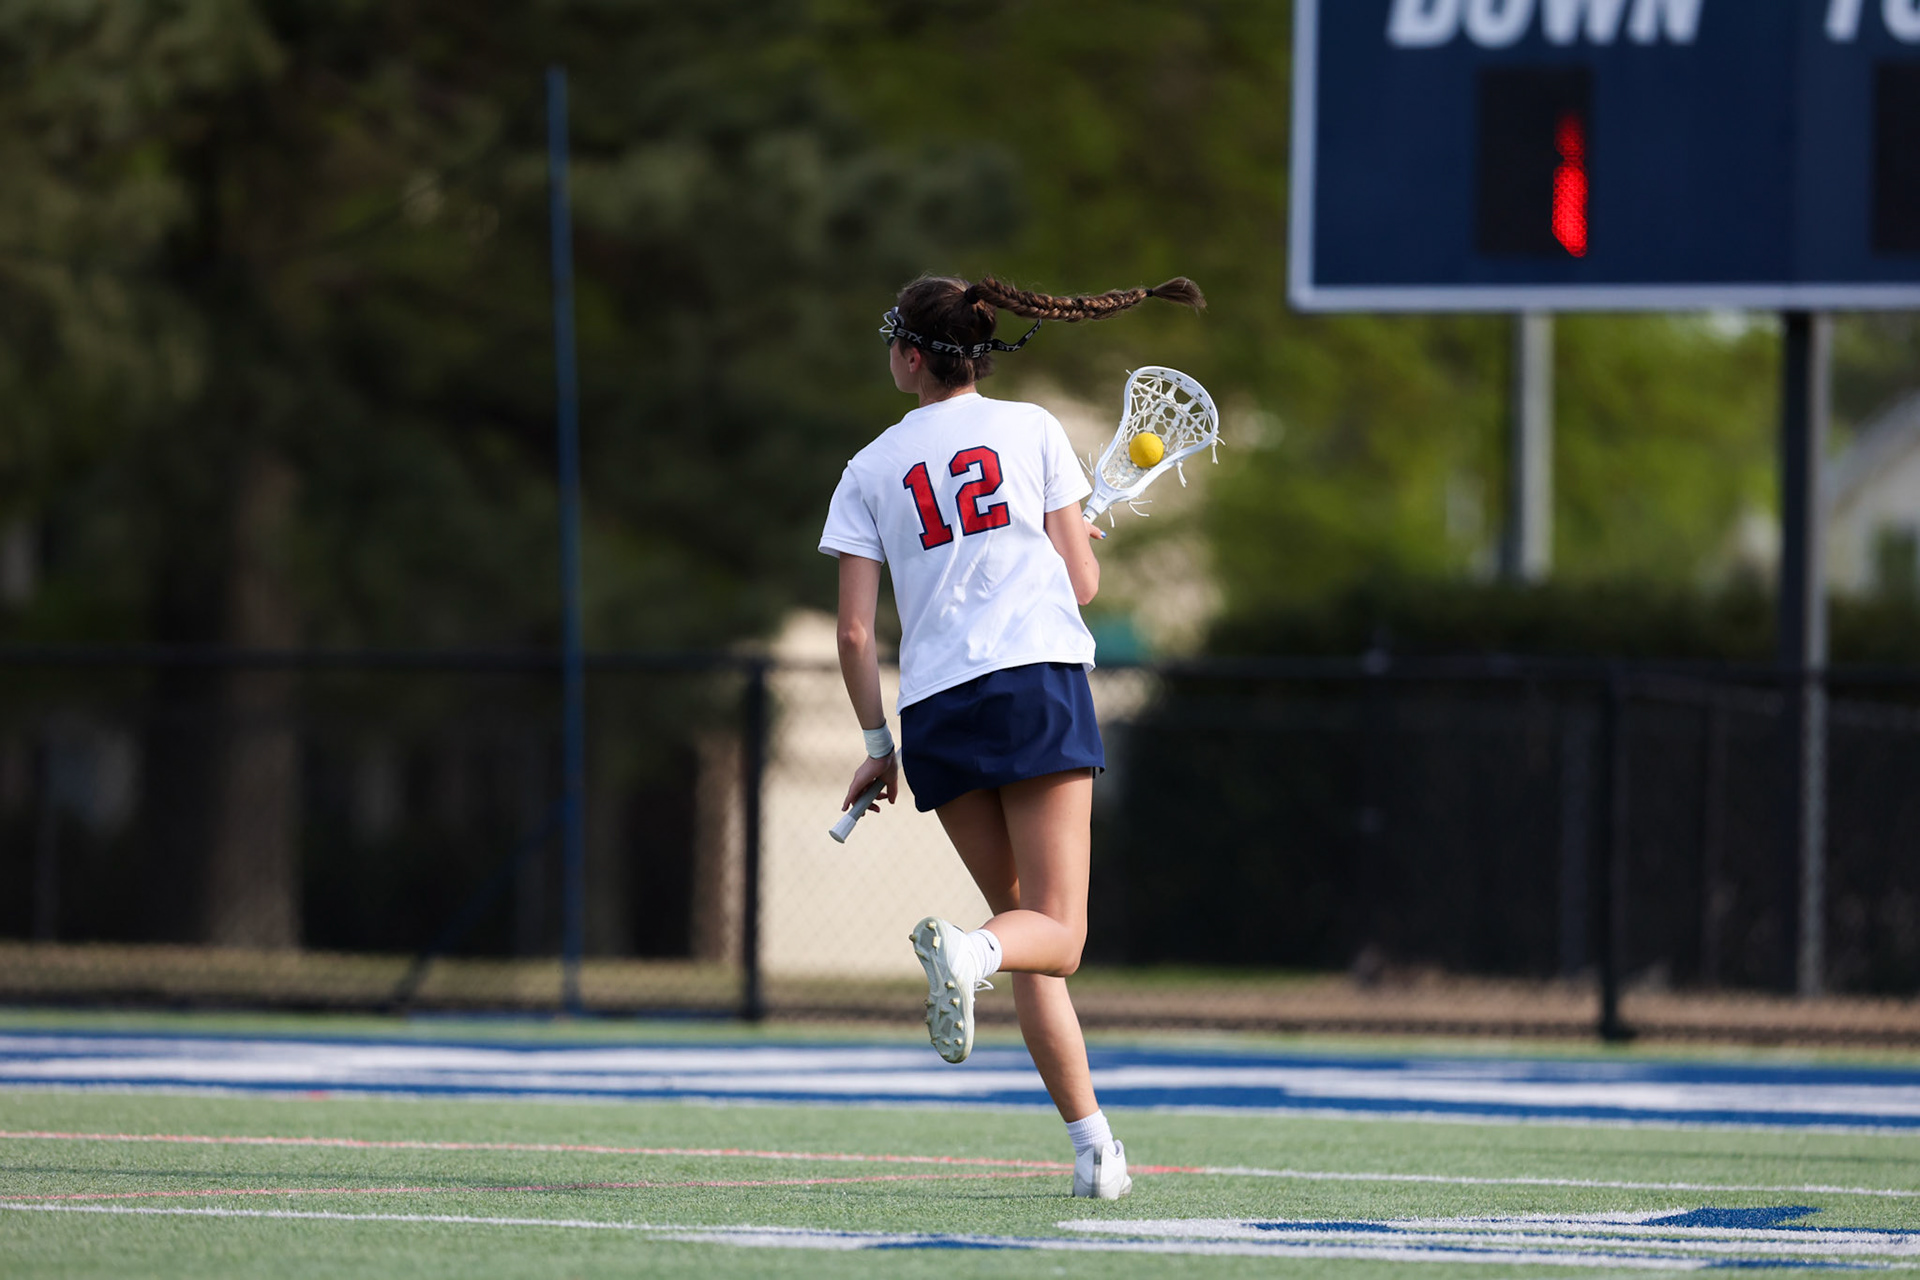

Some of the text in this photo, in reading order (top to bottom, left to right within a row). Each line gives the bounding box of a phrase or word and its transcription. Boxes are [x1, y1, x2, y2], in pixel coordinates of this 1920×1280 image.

[896, 327, 922, 344] STX
[932, 340, 964, 354] STX
[904, 445, 1011, 551] 12
